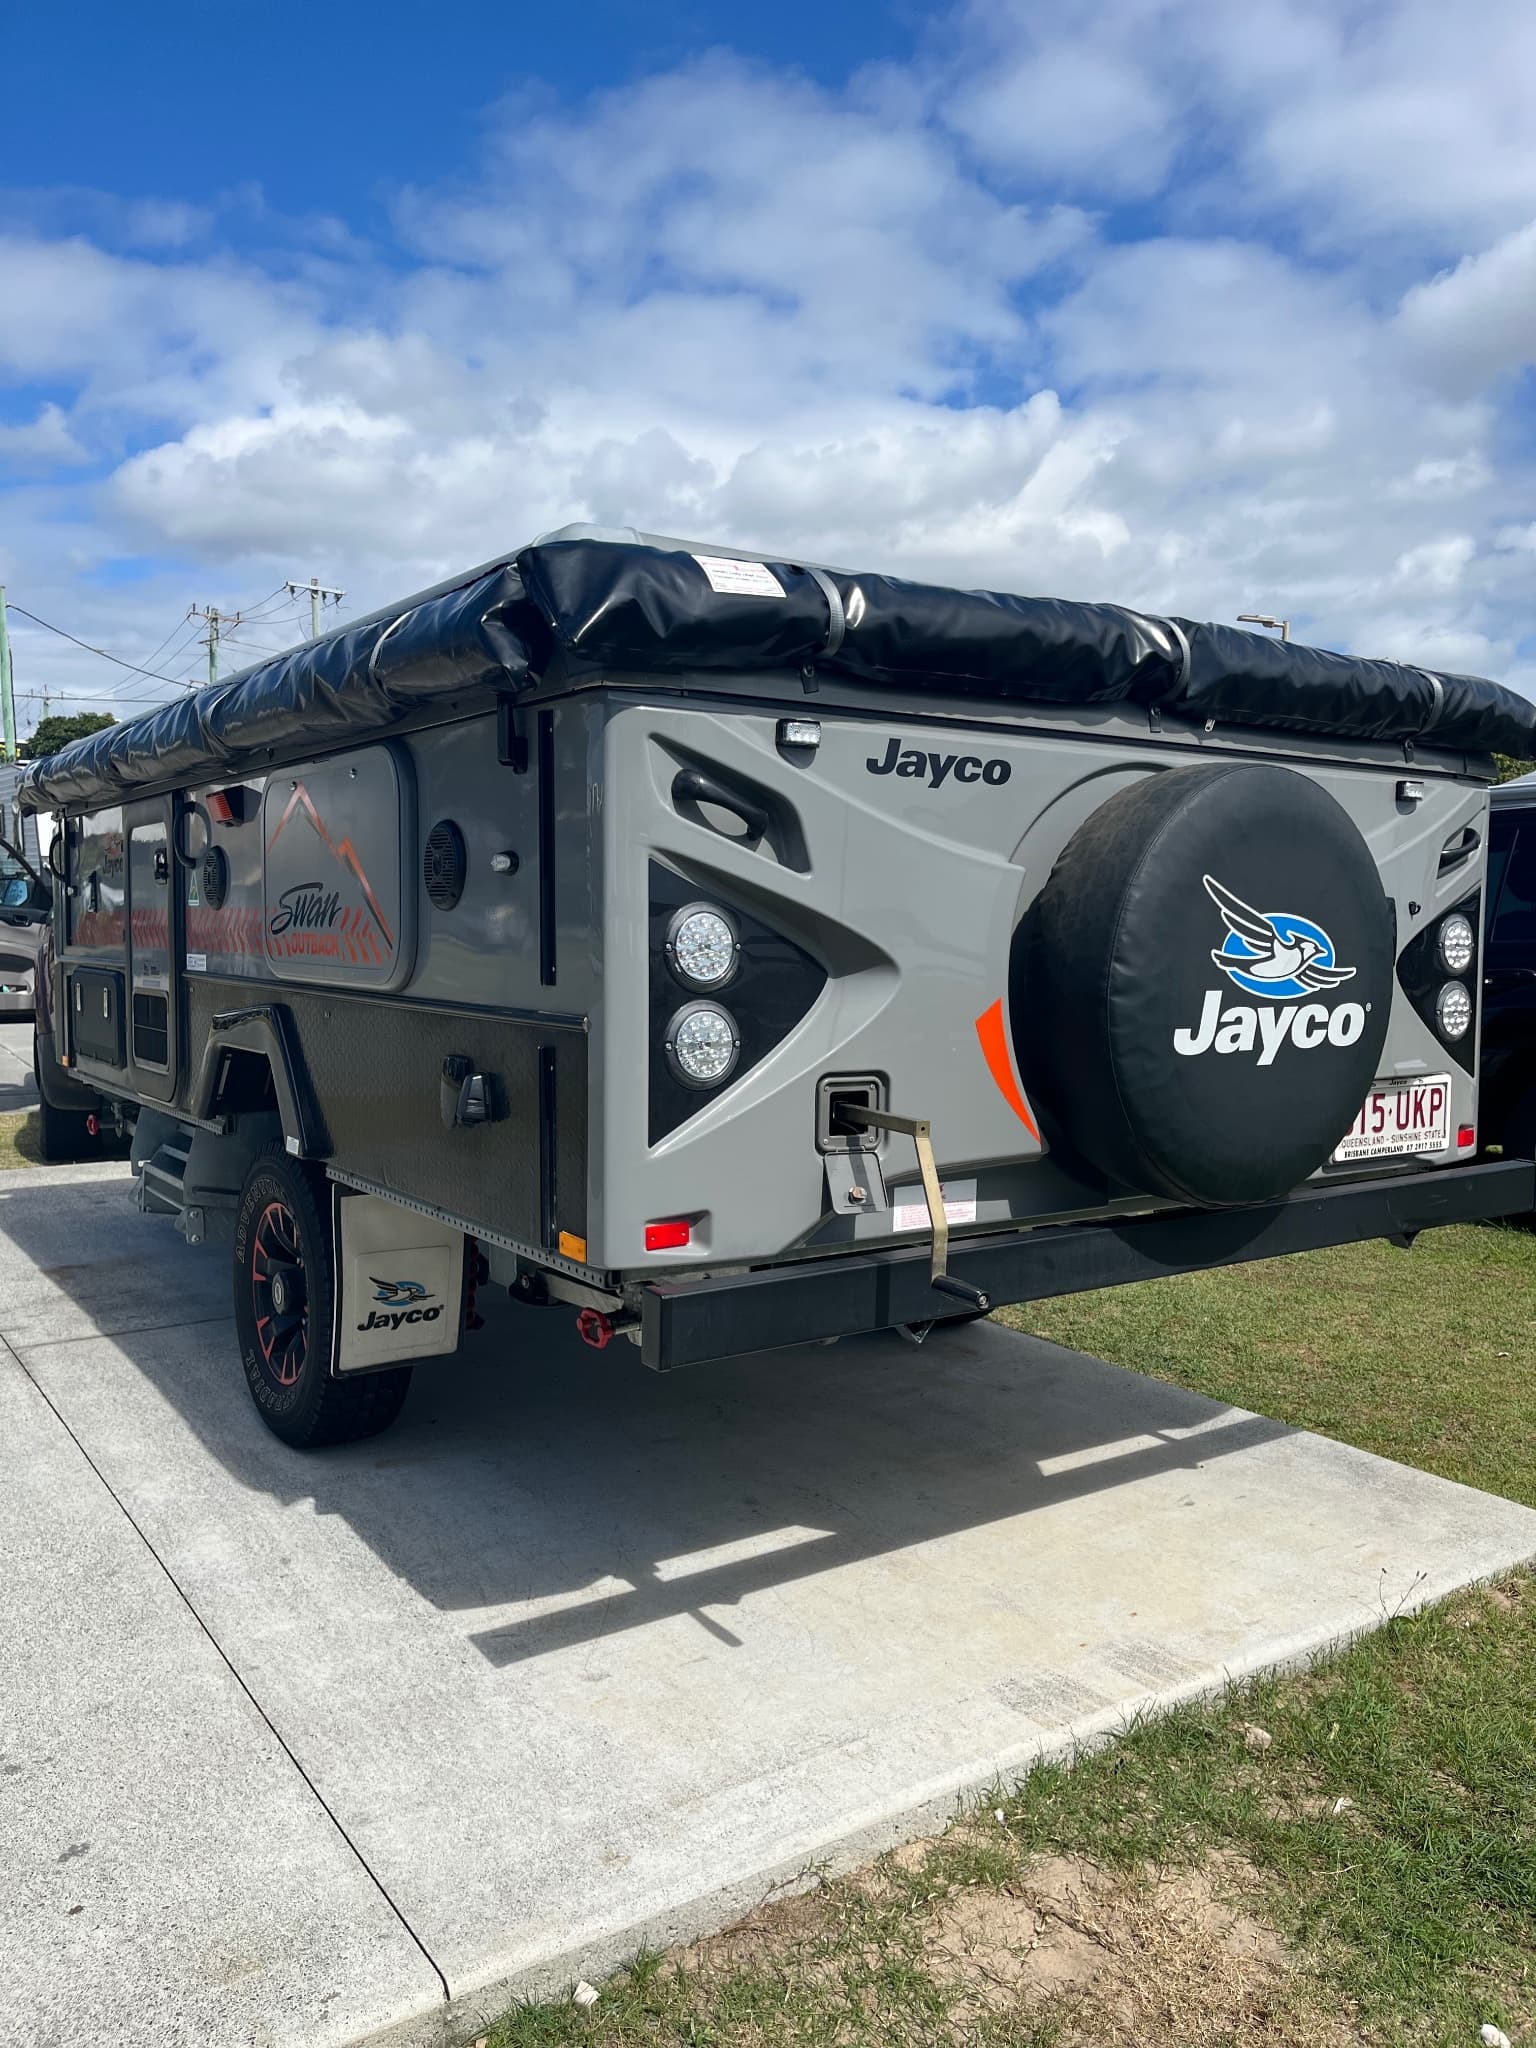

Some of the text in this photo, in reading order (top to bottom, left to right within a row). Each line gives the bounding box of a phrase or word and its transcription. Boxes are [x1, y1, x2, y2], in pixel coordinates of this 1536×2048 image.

[866, 737, 1012, 789] Jayco
[271, 882, 342, 935] Swan
[291, 932, 339, 956] OUTBACK
[1173, 990, 1366, 1066] Jayco
[1341, 1136, 1385, 1149] QUEENSLAND
[1391, 1132, 1421, 1144] SUNSHINE
[1424, 1129, 1441, 1140] STATE
[1344, 1149, 1369, 1158] BRISBANE
[1370, 1145, 1404, 1155] CAMPERLAND
[356, 1306, 440, 1331] Jayco
